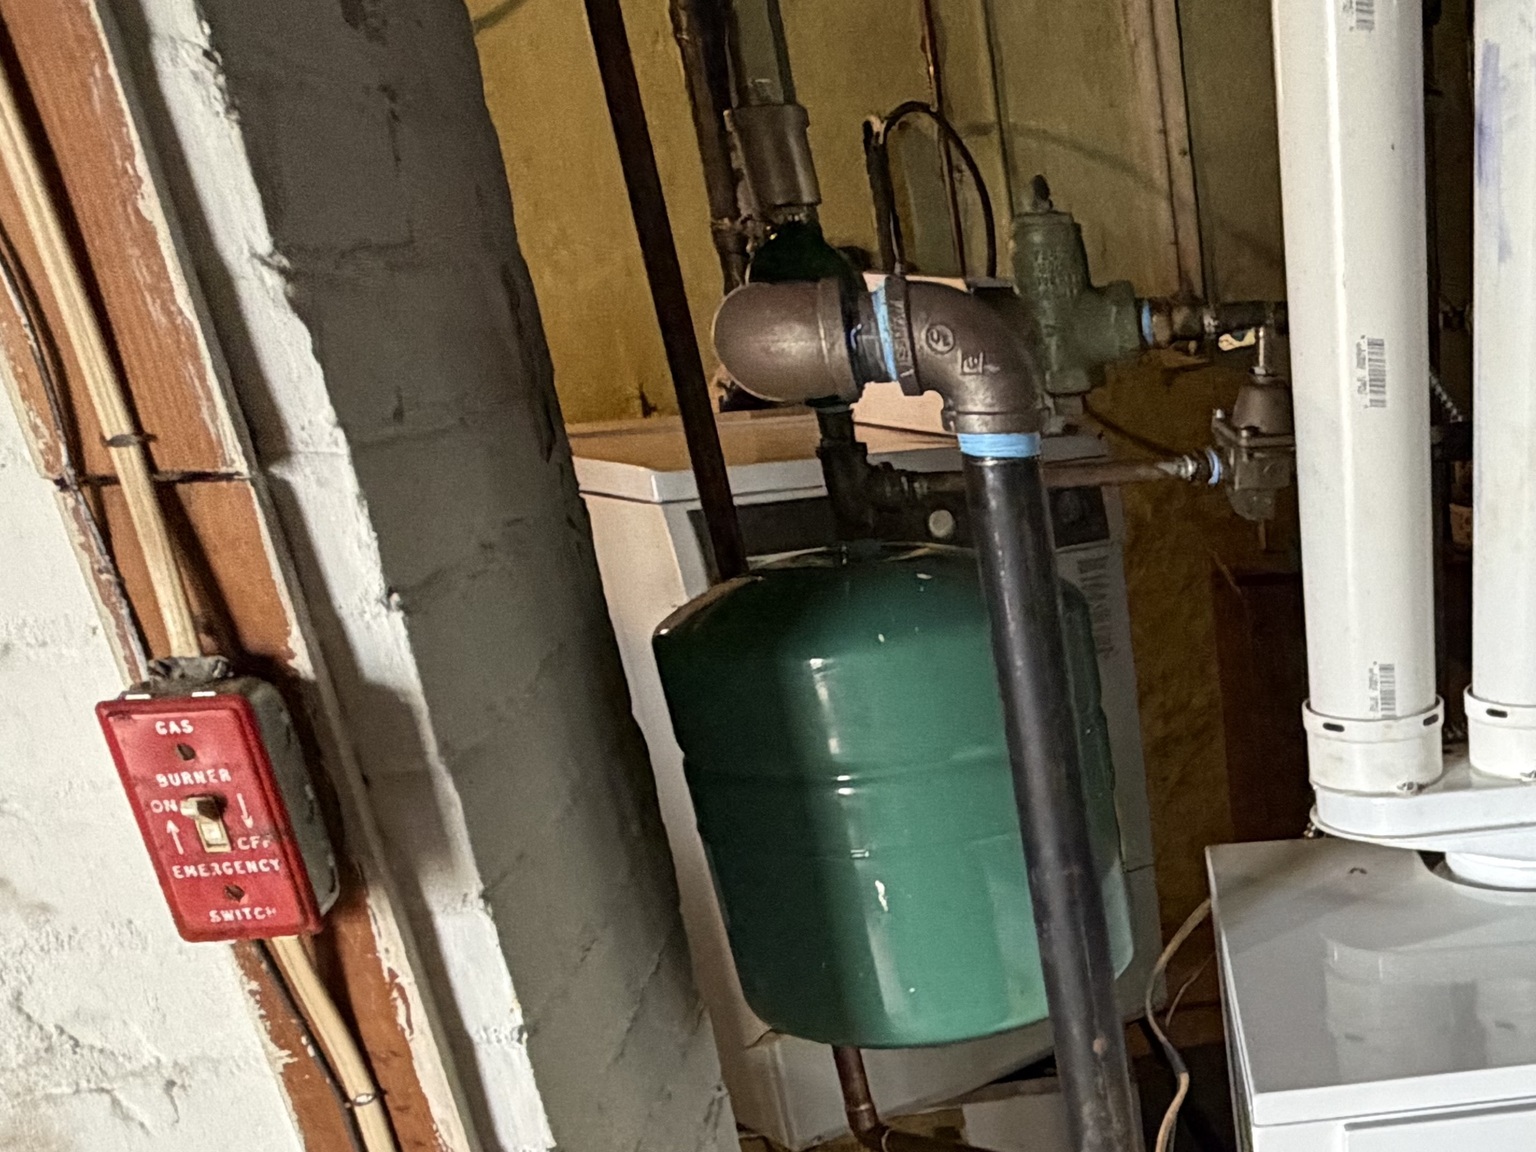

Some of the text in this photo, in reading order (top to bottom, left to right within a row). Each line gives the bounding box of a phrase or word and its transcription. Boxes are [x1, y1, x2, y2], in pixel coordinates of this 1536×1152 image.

[155, 719, 194, 735] GAS
[155, 768, 232, 788] BURNER
[150, 799, 178, 814] ON
[172, 858, 281, 879] EMERGENCY
[208, 906, 277, 923] SWITCH
